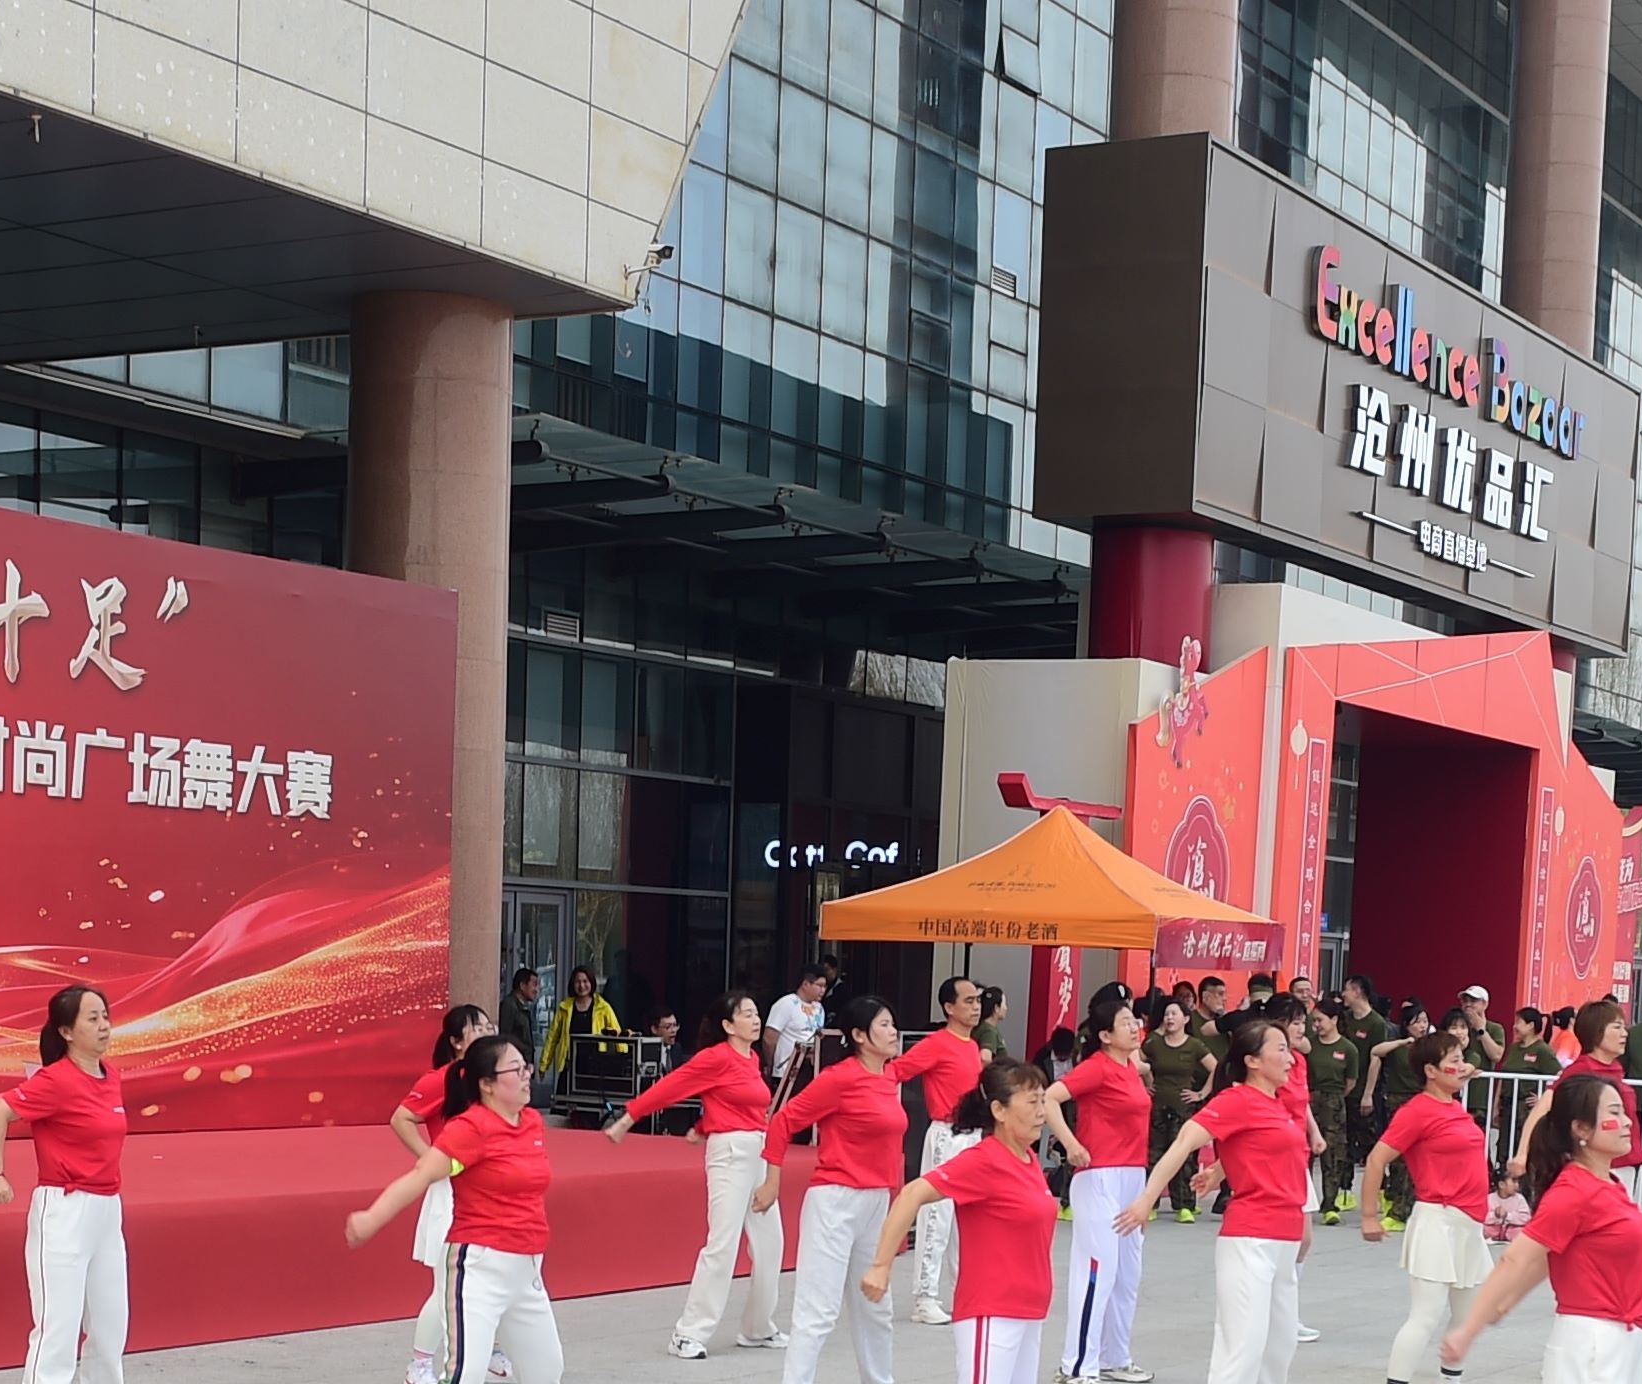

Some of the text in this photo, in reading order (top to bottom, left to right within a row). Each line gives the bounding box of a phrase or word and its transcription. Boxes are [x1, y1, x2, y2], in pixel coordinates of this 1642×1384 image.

[1317, 244, 1587, 460] Excellence Bazaar
[1349, 383, 1555, 542] 沧州优品汇
[1419, 520, 1488, 573] 电商直播基地
[918, 917, 1059, 941] 中国高端年份老酒
